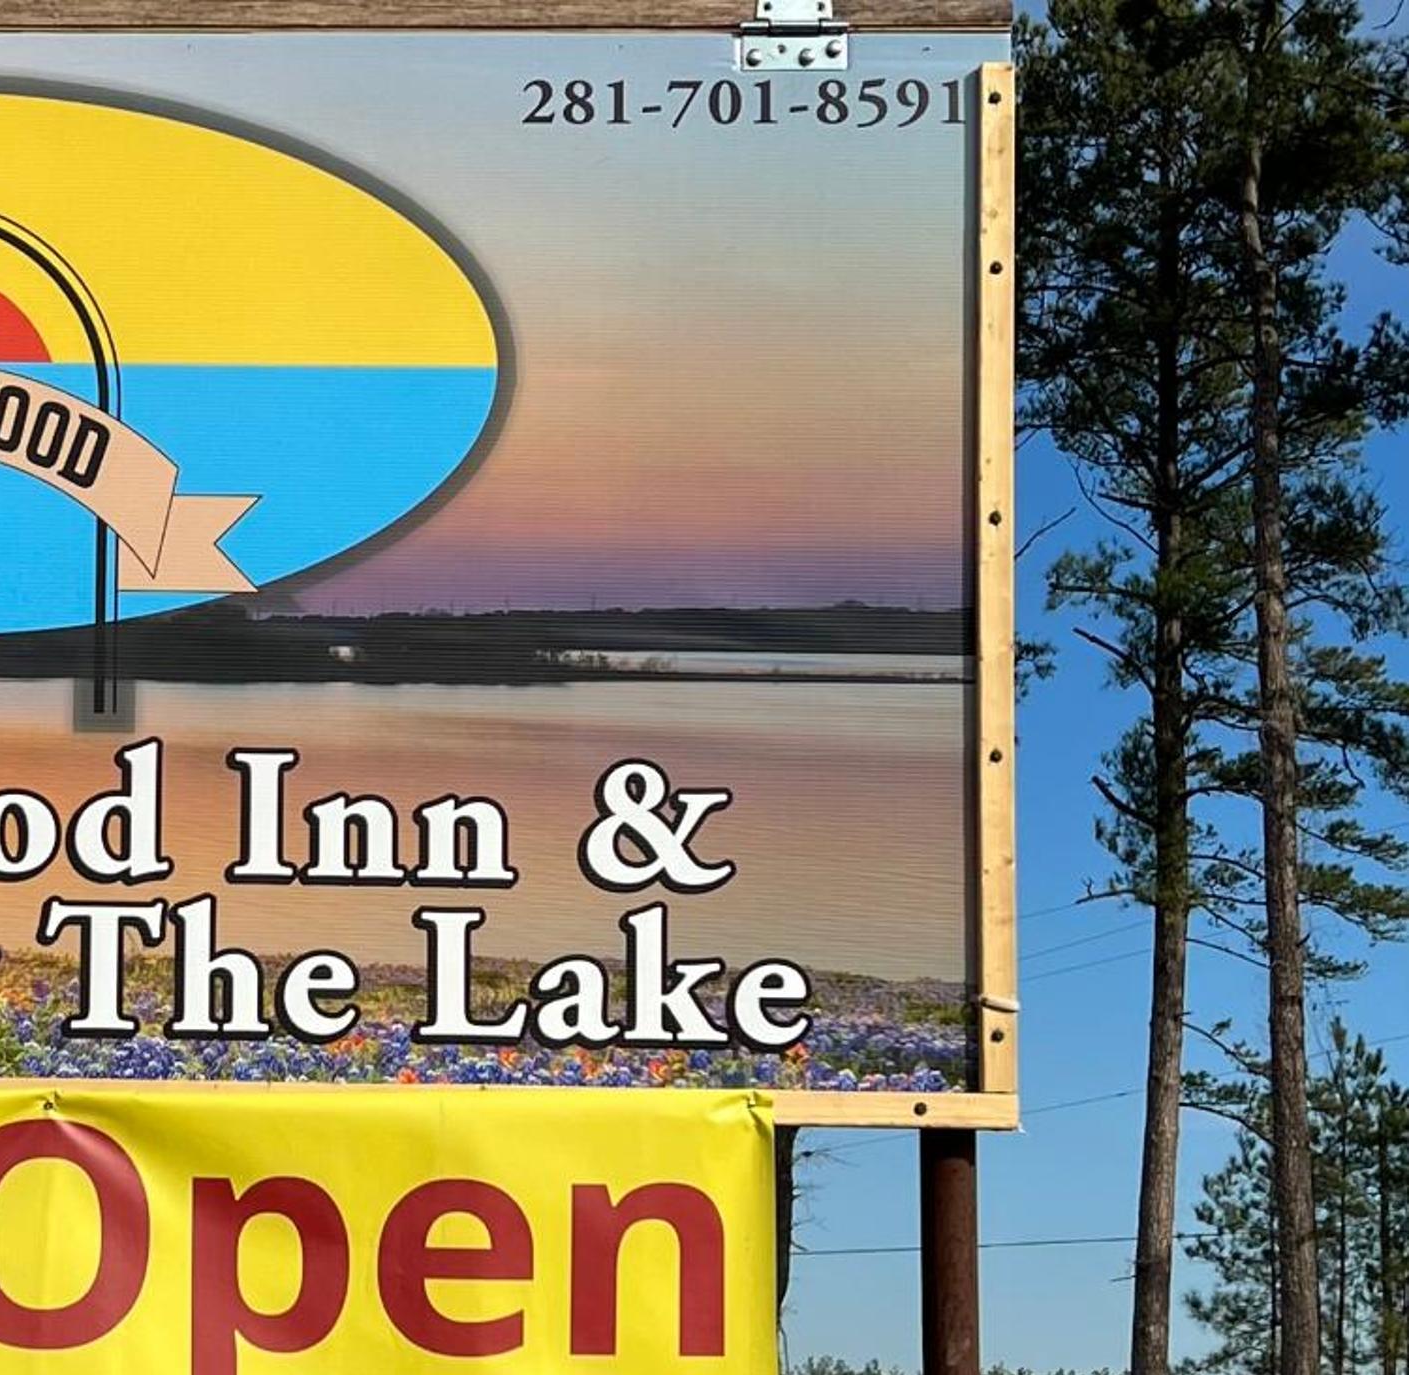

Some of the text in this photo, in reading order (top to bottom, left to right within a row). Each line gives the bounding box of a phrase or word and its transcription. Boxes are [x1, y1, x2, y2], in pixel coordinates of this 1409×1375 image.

[522, 78, 966, 128] 281-701-8591
[226, 748, 518, 887] Inn
[577, 758, 735, 894] &
[36, 894, 360, 1045] The
[411, 901, 812, 1052] Lake
